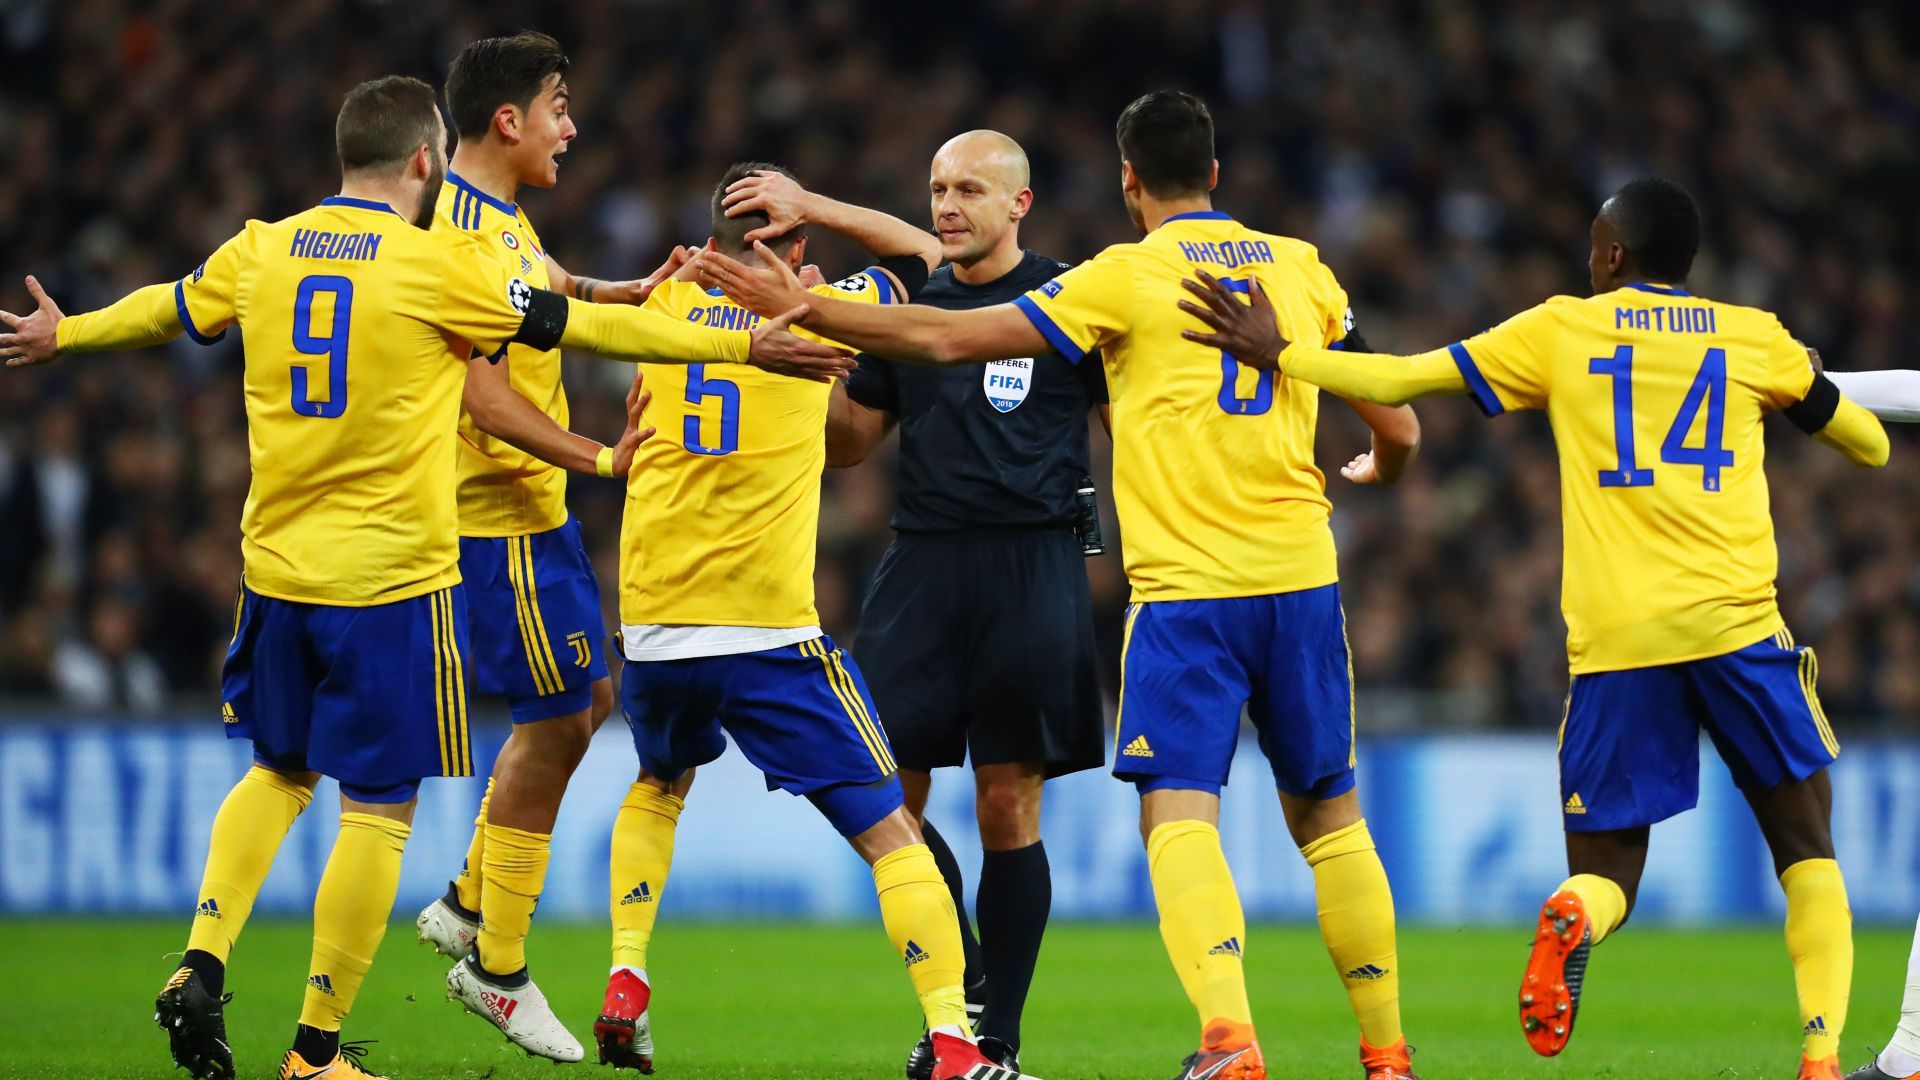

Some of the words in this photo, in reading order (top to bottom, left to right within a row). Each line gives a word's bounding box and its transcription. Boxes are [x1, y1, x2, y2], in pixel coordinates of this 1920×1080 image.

[290, 228, 382, 261] HIGUAIN
[1615, 306, 1717, 334] MATUIDI
[290, 274, 354, 418] 9
[989, 374, 1024, 391] FIFA
[683, 363, 741, 456] 5
[996, 400, 1013, 408] 2018
[1588, 345, 1734, 492] 14
[1122, 748, 1154, 758] adidas
[1564, 805, 1588, 815] adidas
[620, 894, 653, 906] adidas
[480, 991, 510, 1032] adidas
